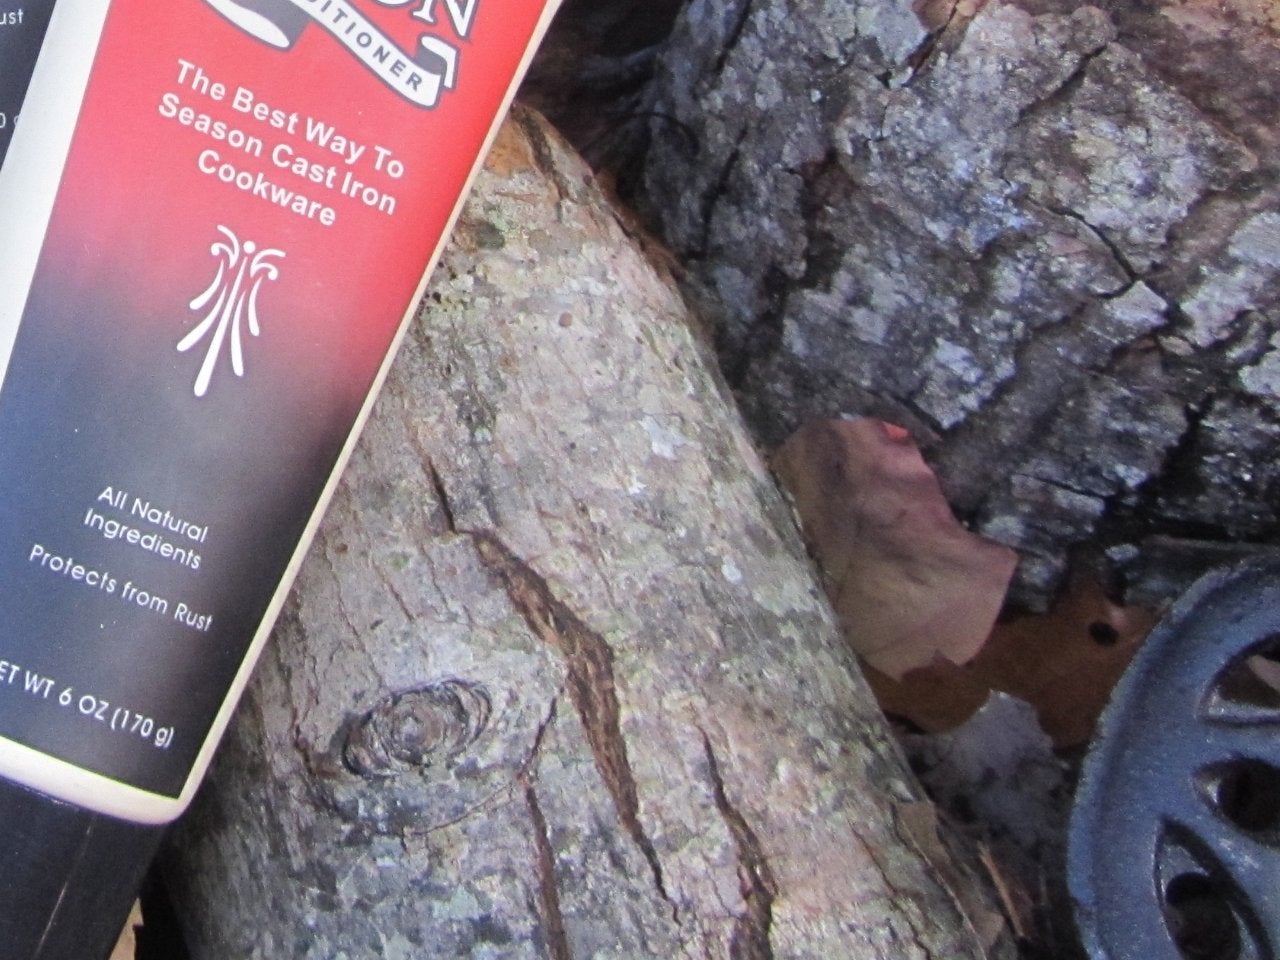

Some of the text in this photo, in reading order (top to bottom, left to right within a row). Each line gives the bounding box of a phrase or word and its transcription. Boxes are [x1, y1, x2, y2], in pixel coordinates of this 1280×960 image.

[157, 93, 397, 216] Season Cast Iron
[176, 58, 405, 180] The Best Way To
[197, 149, 336, 227] Cookware
[84, 508, 202, 570] Ingredients
[97, 486, 209, 543] All Natural
[28, 544, 213, 632] Protects from Rust
[24, 670, 55, 699] WT
[58, 688, 72, 706] 6
[78, 695, 109, 721] OZ
